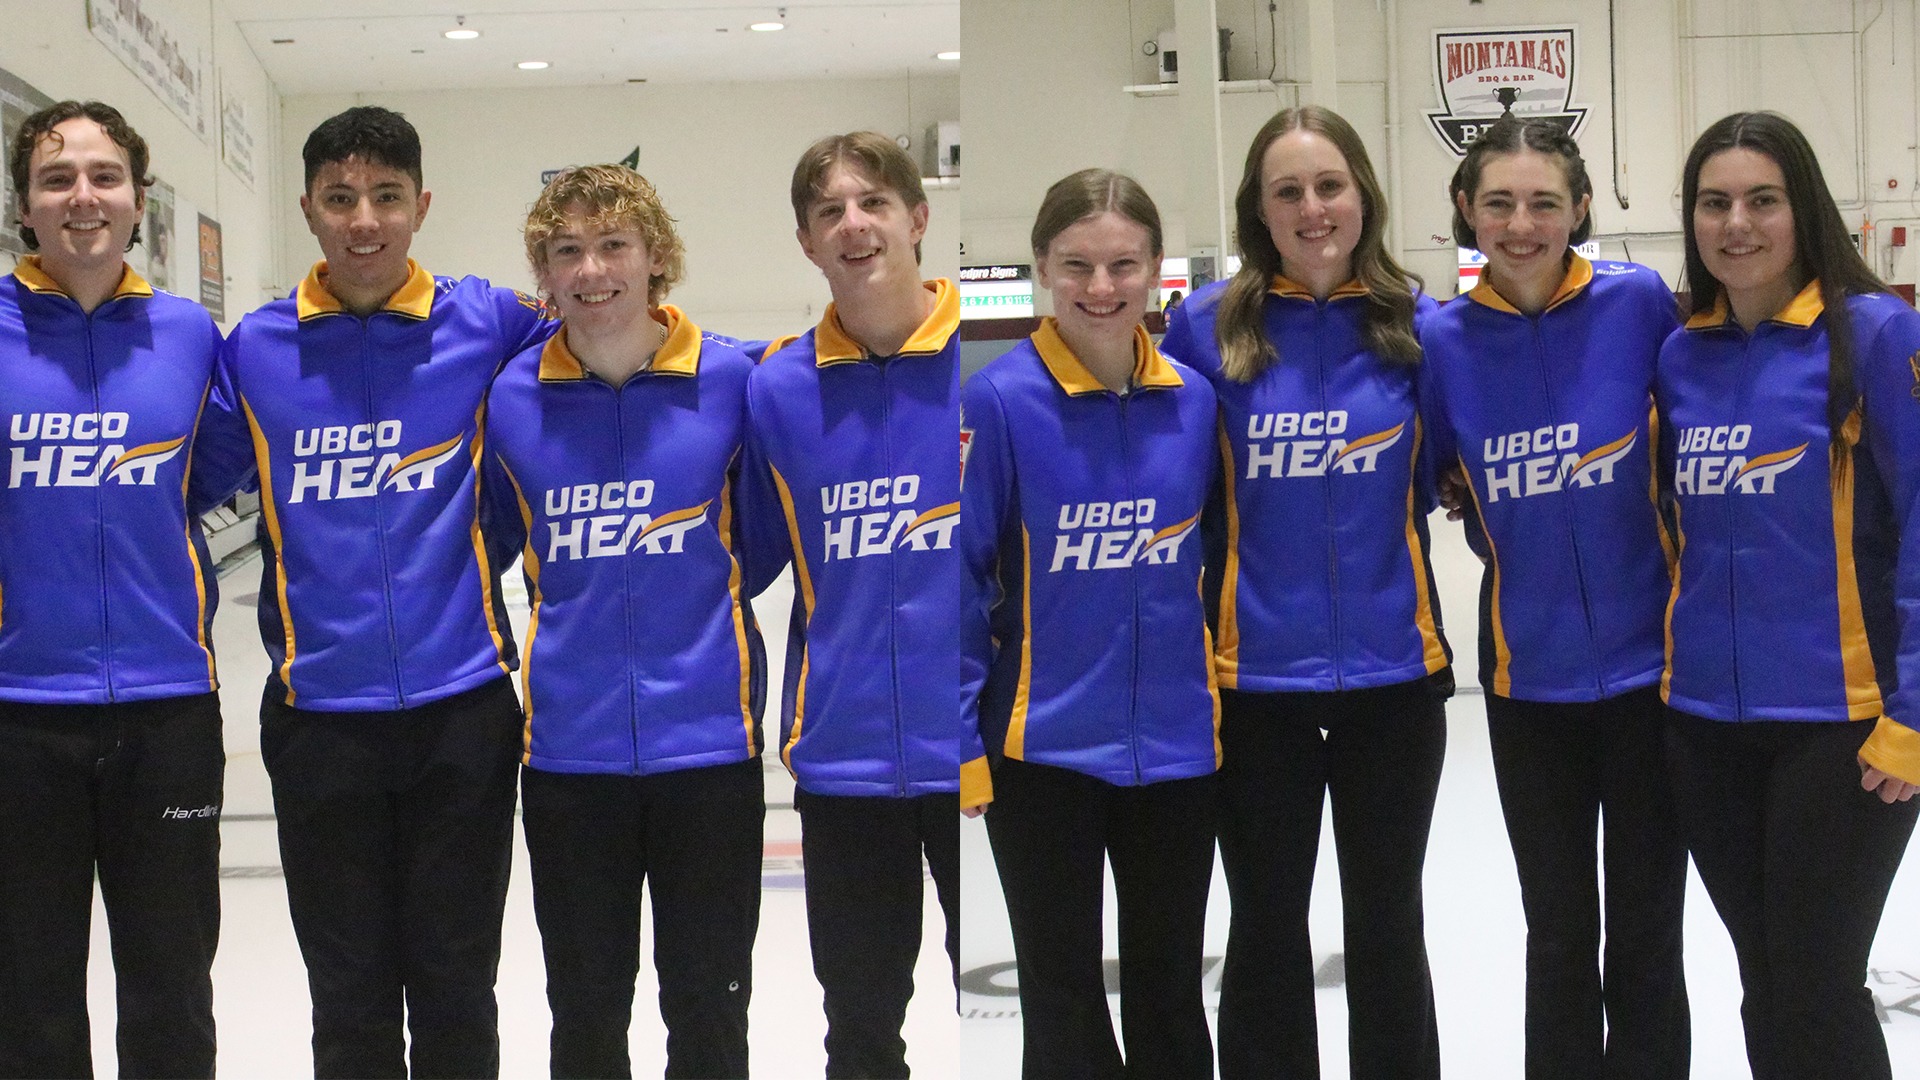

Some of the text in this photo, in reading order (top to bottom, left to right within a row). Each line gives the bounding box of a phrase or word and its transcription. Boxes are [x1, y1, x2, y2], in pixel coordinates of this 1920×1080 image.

[1446, 39, 1566, 83] MONTANA'S
[1478, 75, 1499, 83] BBQ
[960, 266, 1018, 280] edpro Signs
[961, 298, 968, 306] 5
[969, 297, 976, 306] 6
[979, 297, 985, 305] 7
[988, 297, 994, 305] 8
[1005, 296, 1013, 304] 10
[1014, 296, 1022, 304] 11
[1023, 295, 1031, 304] 12
[11, 412, 129, 441] UBCO
[295, 420, 402, 457] UBCO
[1249, 411, 1348, 439] UBCO
[1484, 423, 1580, 462] UBCO
[1679, 425, 1752, 453] UBCO
[9, 436, 186, 488] HEAT
[288, 431, 463, 503] HEAT
[1247, 422, 1405, 478] HEAT
[1484, 427, 1637, 502] HEAT
[1676, 442, 1808, 494] HEAT
[546, 480, 655, 516] UBCO
[821, 475, 920, 514] UBCO
[546, 499, 712, 562] HEAT
[823, 502, 960, 563] HEAT
[1059, 499, 1156, 530] UBCO
[1049, 513, 1198, 572] HEAT
